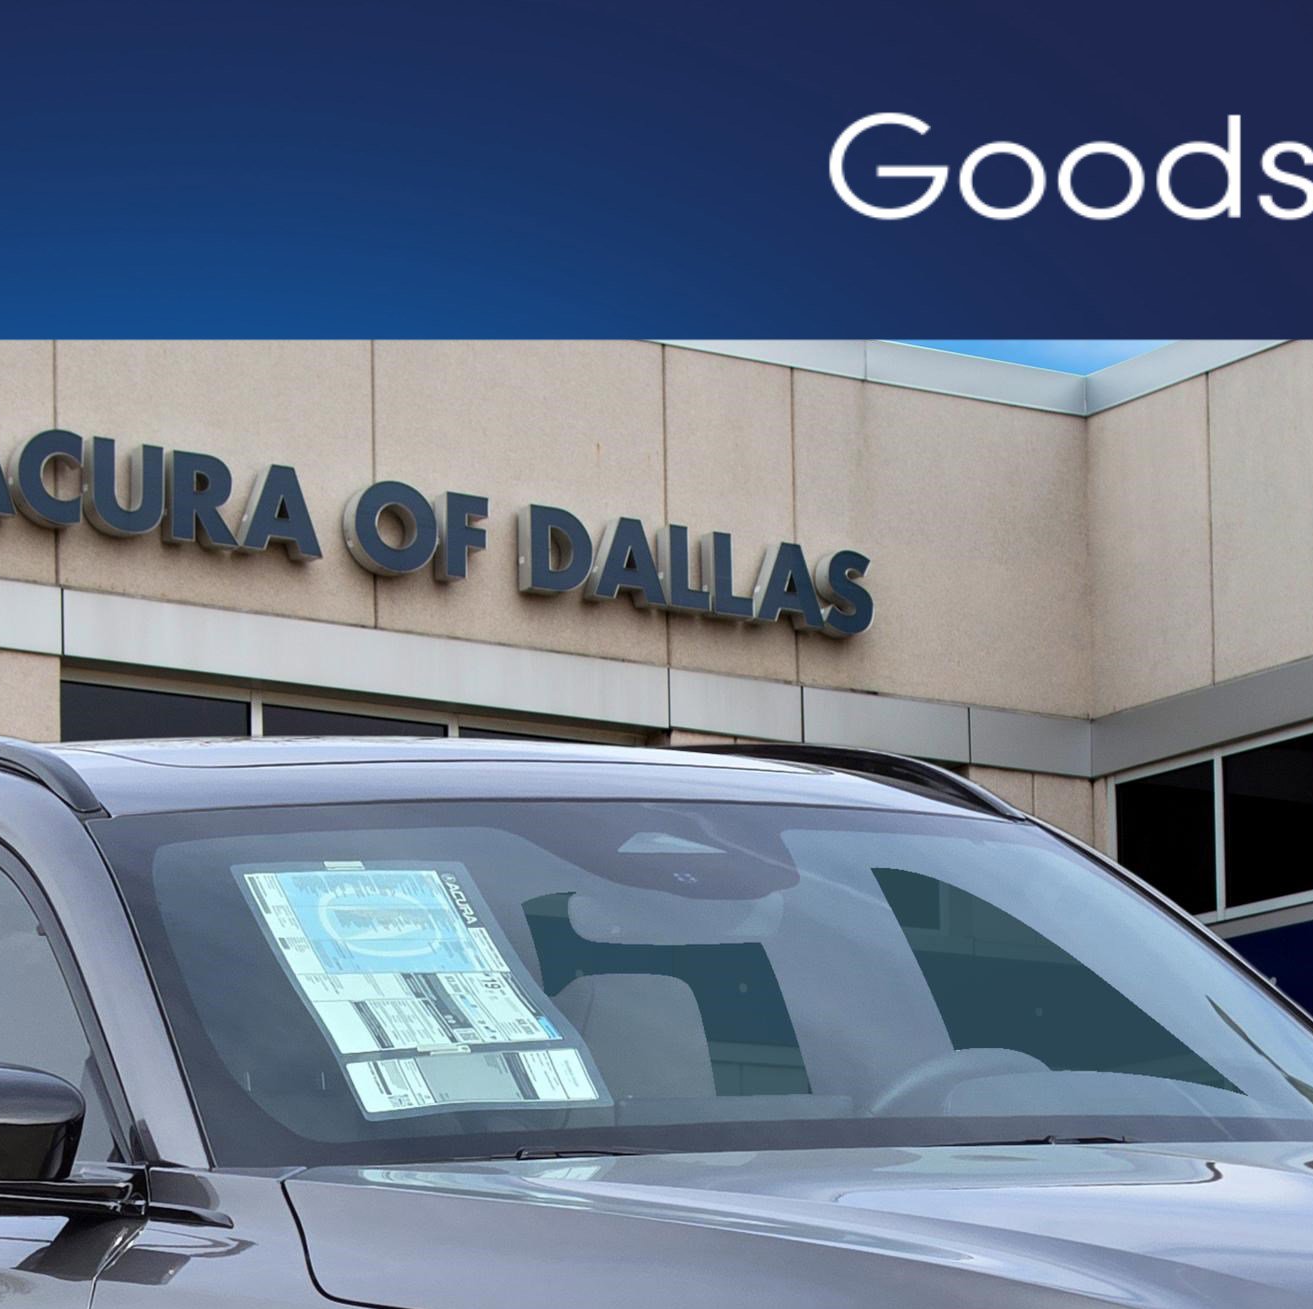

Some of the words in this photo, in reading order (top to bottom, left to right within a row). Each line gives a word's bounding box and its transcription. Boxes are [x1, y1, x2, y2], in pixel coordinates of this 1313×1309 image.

[345, 479, 488, 583] OF
[515, 505, 877, 639] DALLAS
[446, 880, 478, 925] ACURA
